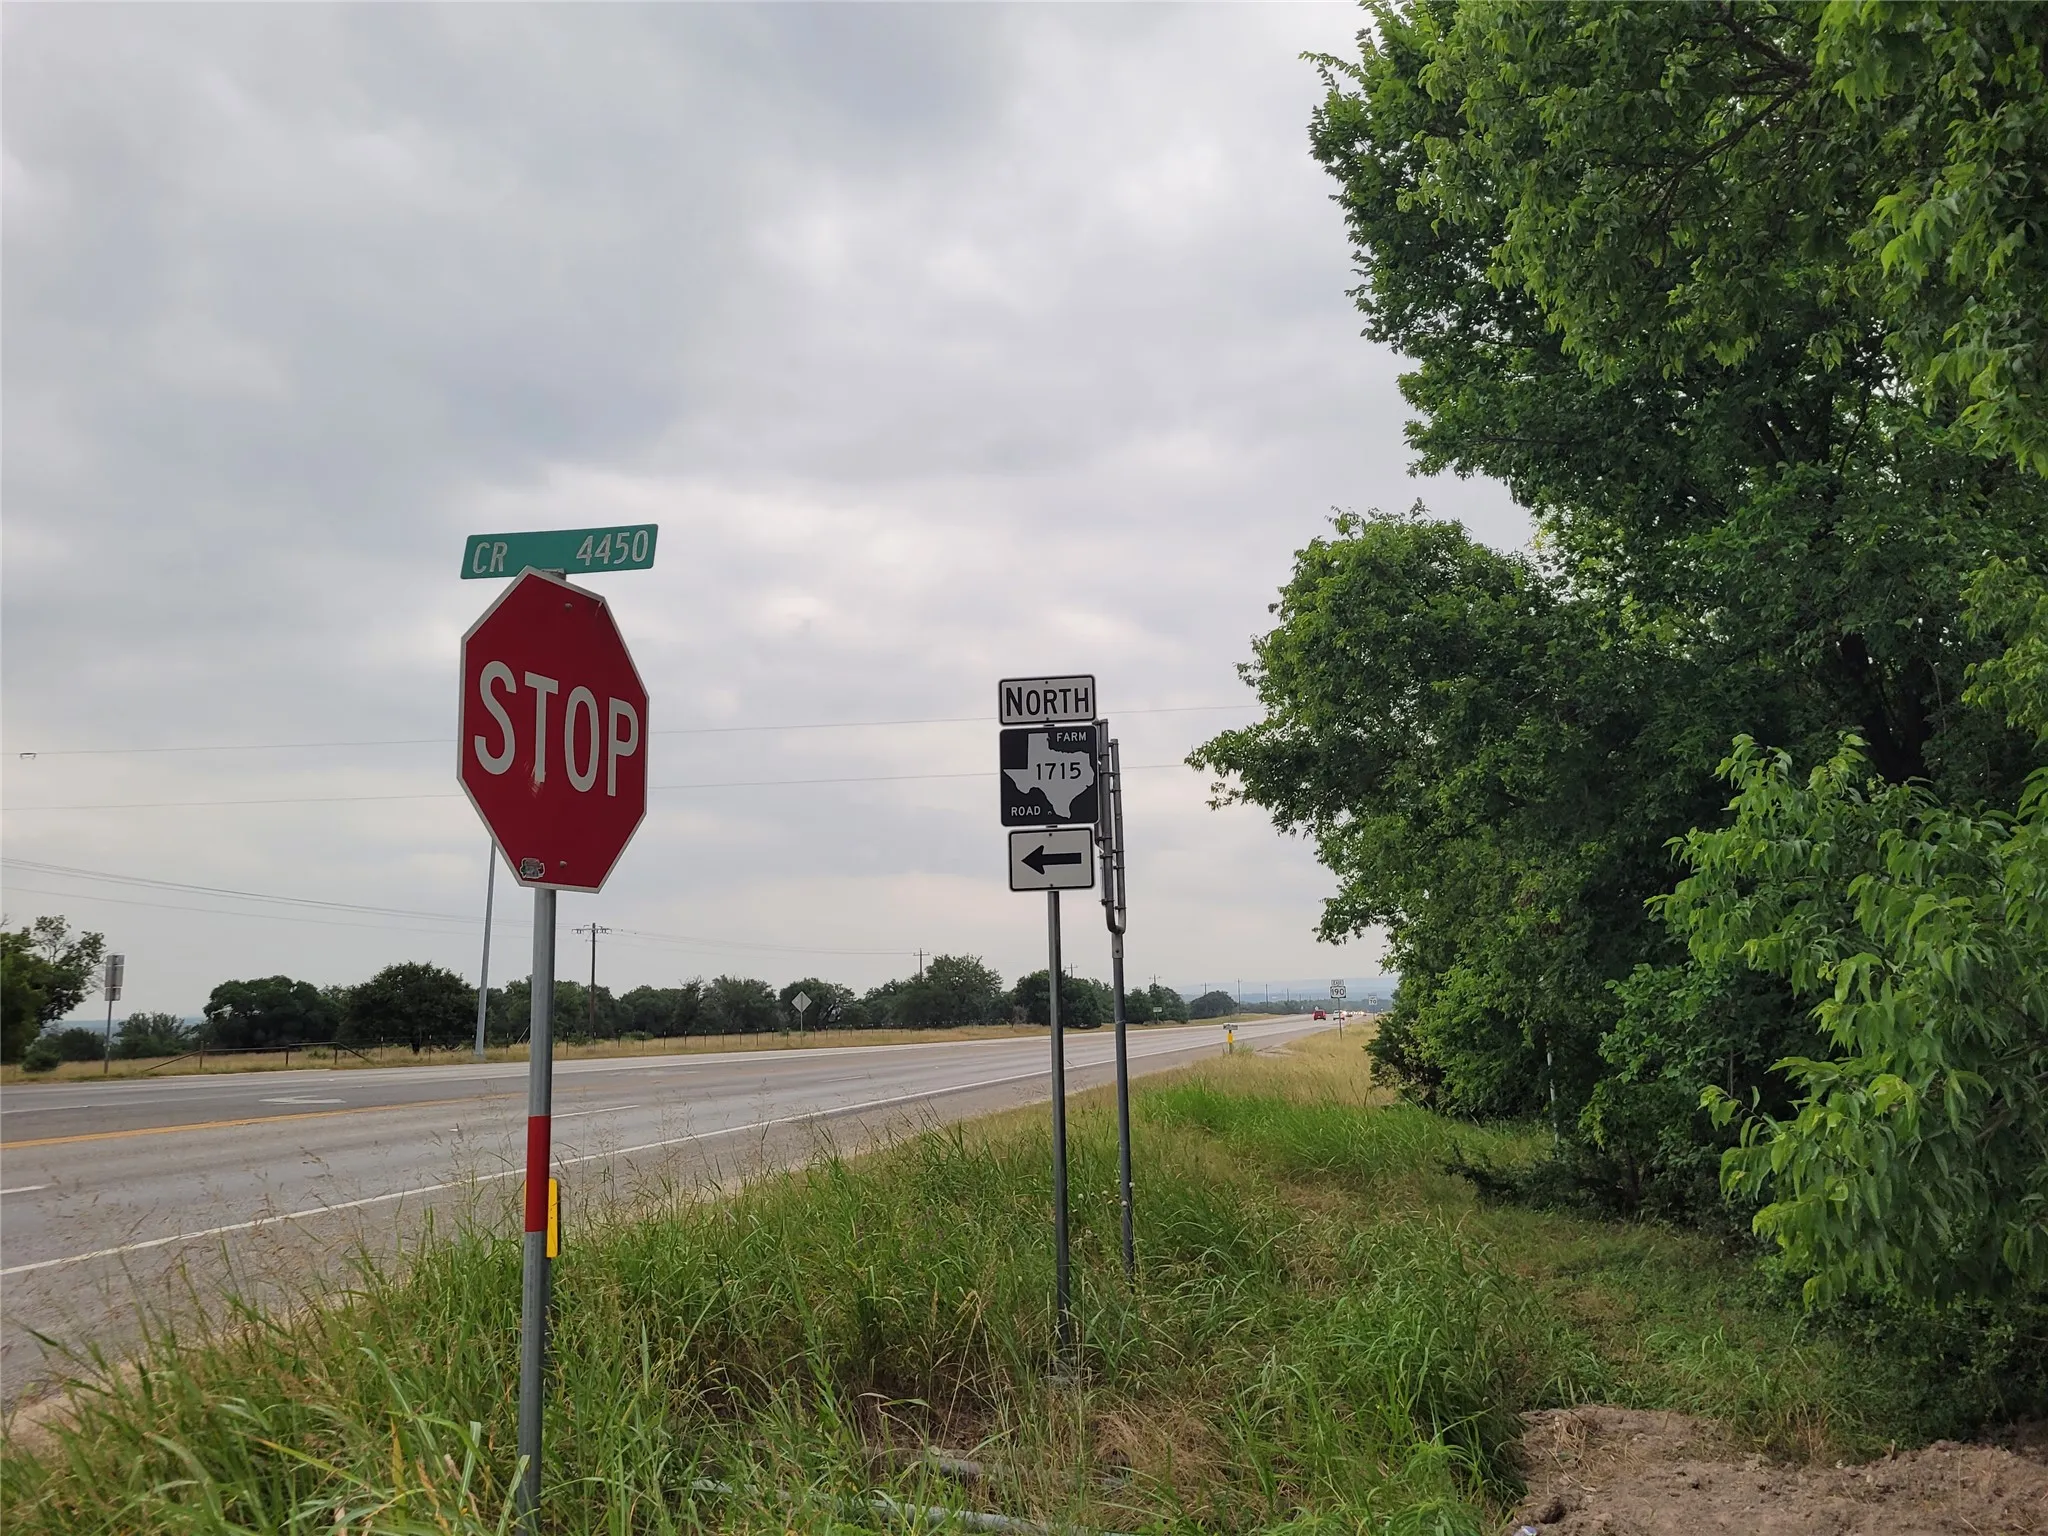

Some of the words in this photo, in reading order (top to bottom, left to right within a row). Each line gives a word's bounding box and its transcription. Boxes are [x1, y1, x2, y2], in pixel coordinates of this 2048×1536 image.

[472, 542, 508, 574] CR
[576, 530, 649, 566] 4450
[1006, 687, 1089, 717] NORTH
[474, 660, 639, 797] STOP
[1056, 732, 1087, 742] FARM
[1036, 762, 1082, 780] 1715
[1011, 806, 1041, 816] ROAD
